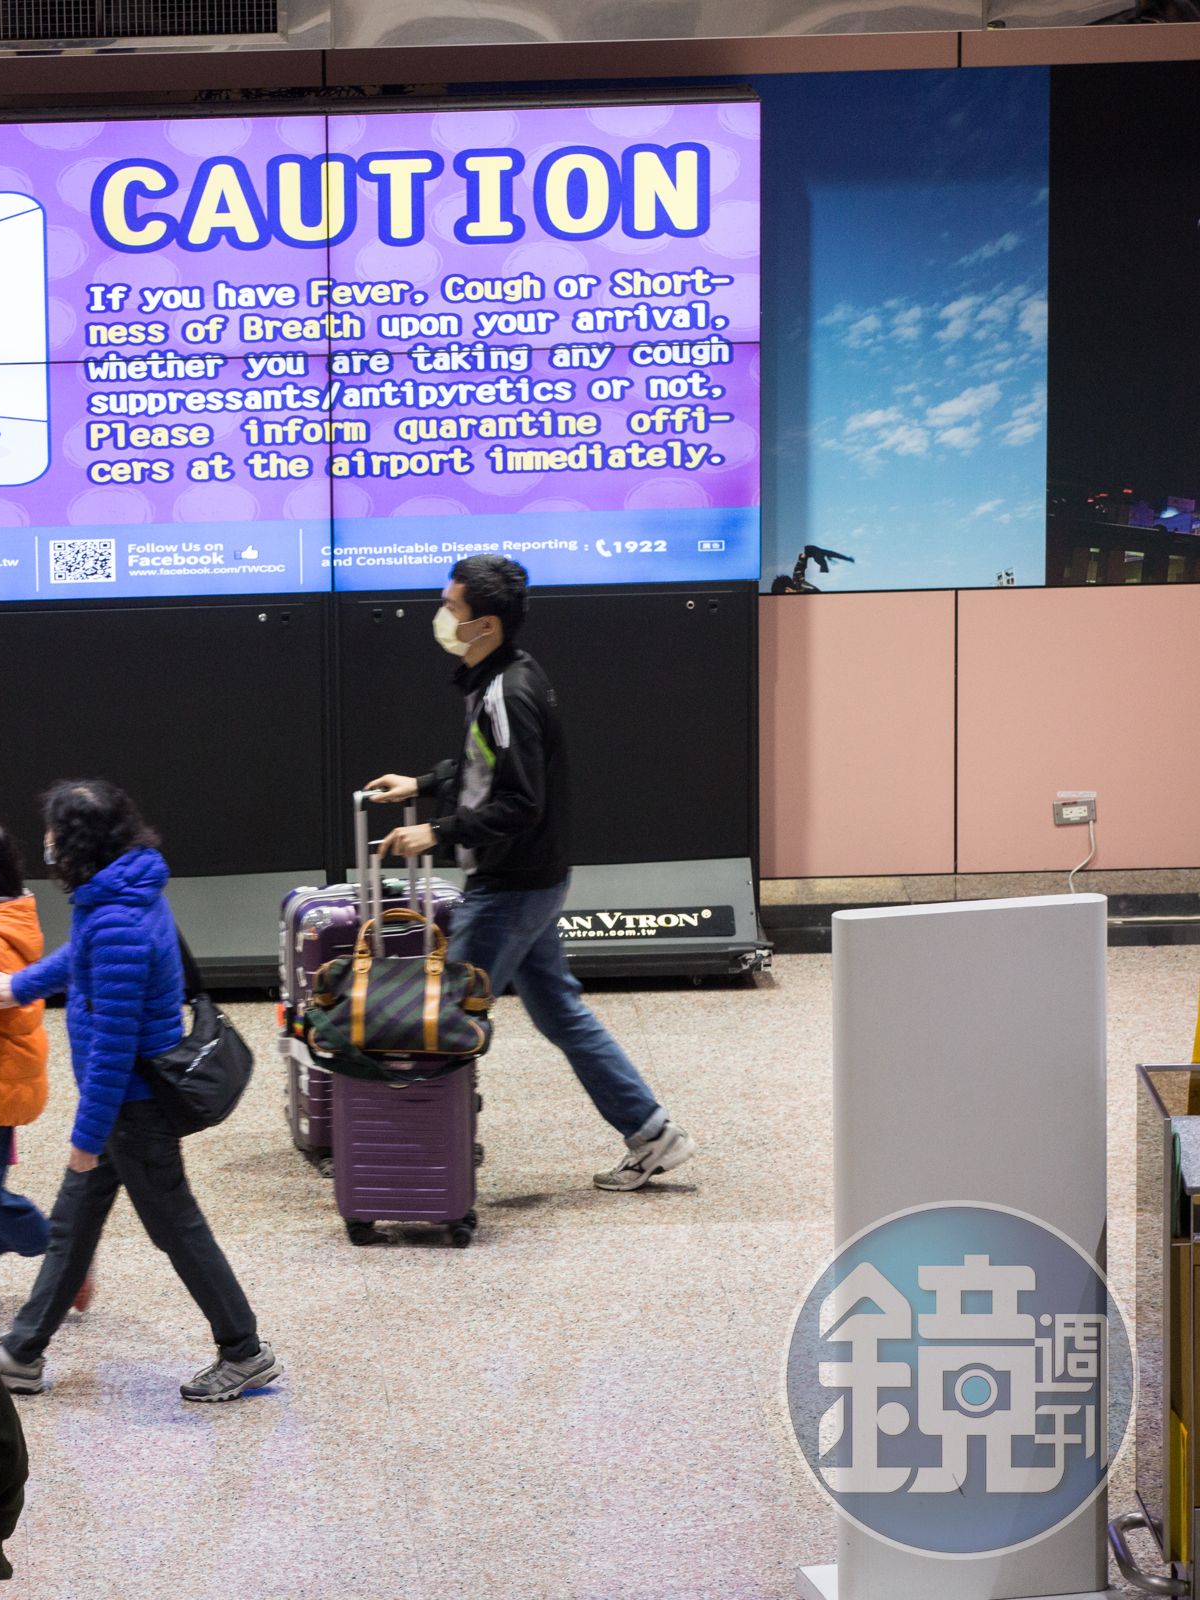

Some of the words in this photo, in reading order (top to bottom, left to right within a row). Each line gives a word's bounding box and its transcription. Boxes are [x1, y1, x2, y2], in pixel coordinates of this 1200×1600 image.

[98, 148, 702, 248] CAUTION
[87, 284, 128, 314] If
[141, 287, 203, 315] you
[216, 281, 298, 311] have
[308, 278, 427, 308] Fever,
[444, 273, 542, 308] Cough
[556, 275, 598, 299] or
[611, 268, 733, 298] Short-
[87, 318, 166, 347] ness
[183, 314, 228, 343] of
[241, 311, 363, 342] Breath
[379, 310, 460, 341] upon
[476, 308, 557, 338] your
[573, 300, 729, 334] arrival,
[87, 351, 226, 382] whether
[242, 350, 308, 381] you
[329, 346, 392, 375] are
[410, 343, 530, 377] taking
[551, 342, 617, 373] any
[631, 337, 732, 370] cough
[88, 376, 573, 418] suppressants/antipyretics
[589, 376, 632, 402] or
[647, 372, 726, 402] not,
[88, 419, 211, 451] Please
[243, 416, 369, 447] inform
[397, 410, 599, 444] quarantine
[629, 406, 733, 436] offi-
[88, 457, 172, 485] cers
[188, 454, 232, 482] at
[246, 451, 310, 481] the
[329, 446, 473, 479] airport
[487, 441, 725, 475] immediately.
[127, 542, 178, 554] Follow
[181, 542, 201, 552] Us
[204, 543, 224, 551] on
[127, 552, 224, 567] Facebook
[320, 544, 438, 556] Communicable
[441, 541, 499, 552] Disease
[503, 539, 578, 552] Reporting
[321, 555, 352, 567] and
[356, 554, 453, 566] Consultation
[613, 540, 667, 553] 1922
[129, 564, 286, 576] www.facebook.com/TWCDC
